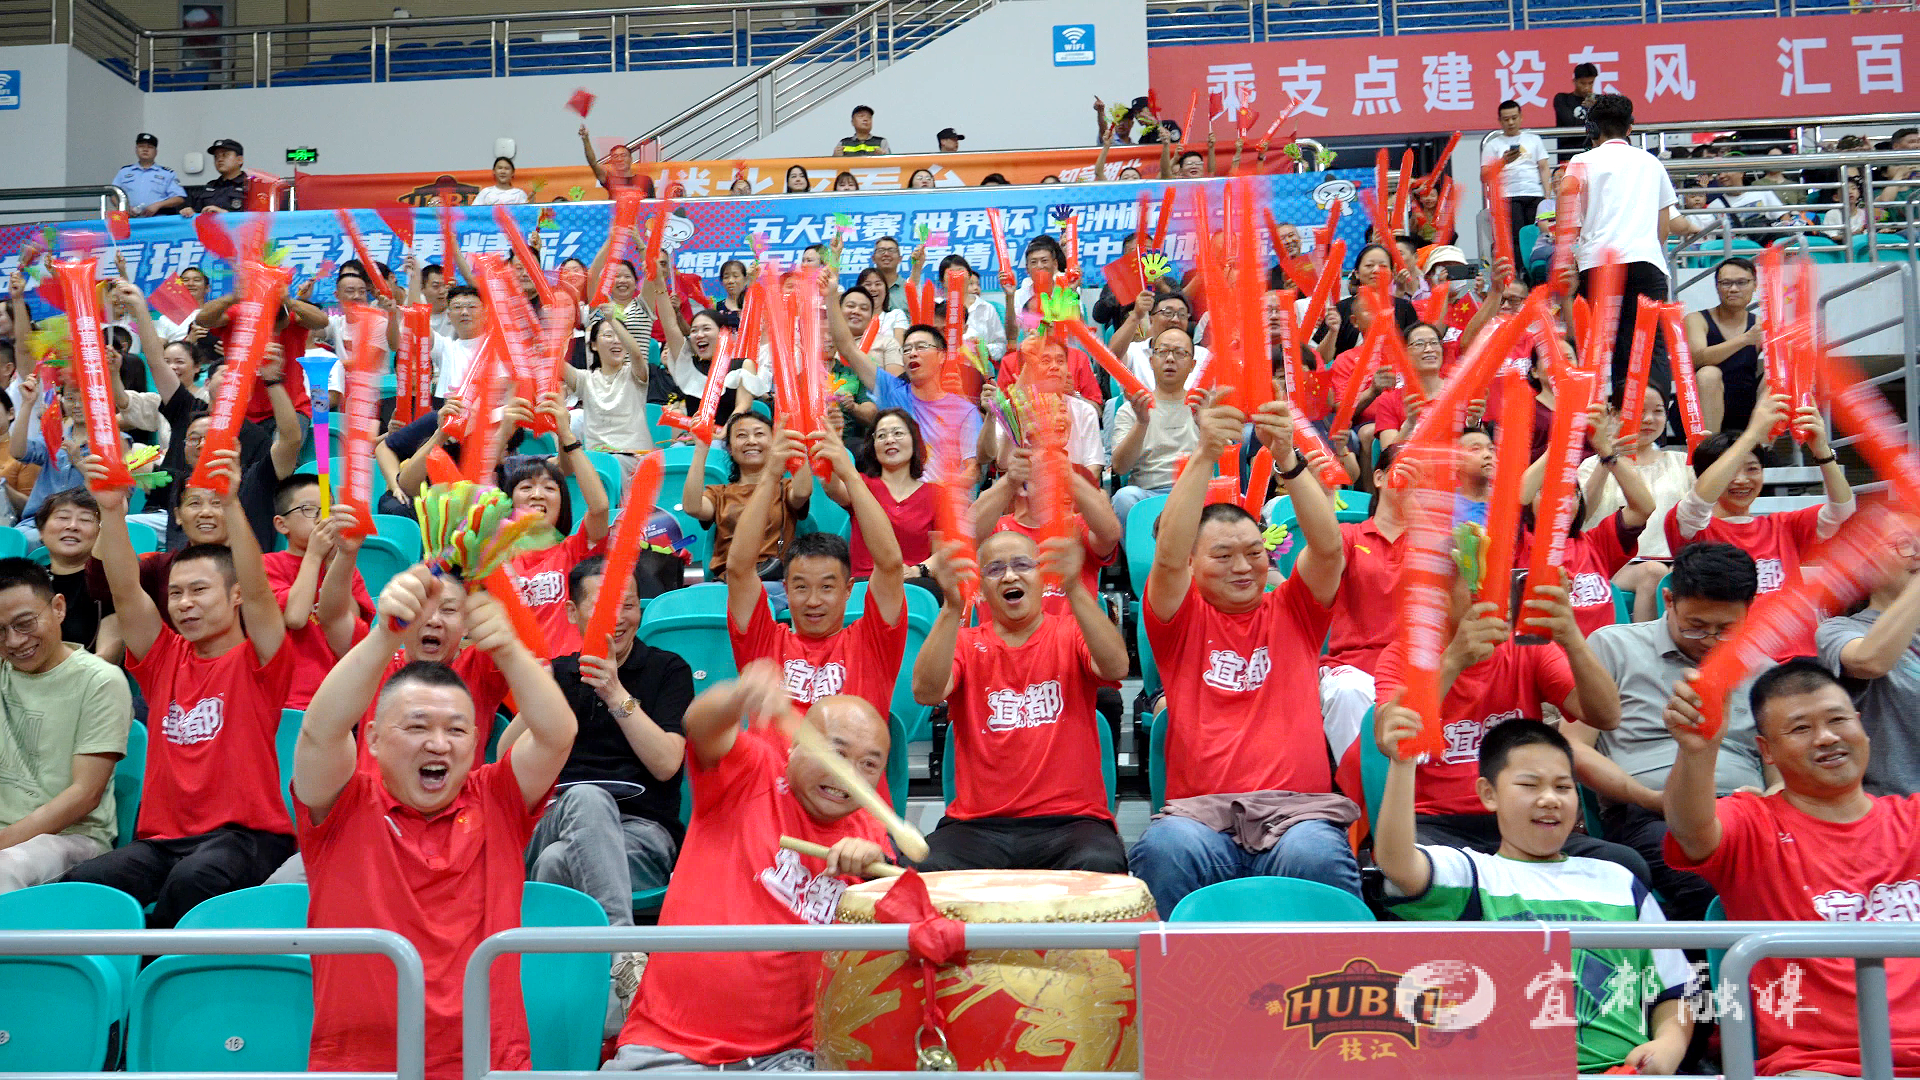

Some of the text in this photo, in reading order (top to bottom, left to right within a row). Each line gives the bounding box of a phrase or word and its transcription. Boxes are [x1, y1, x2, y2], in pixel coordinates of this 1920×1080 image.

[1206, 34, 1904, 123] 乘支点建设东风 汇百
[748, 213, 903, 245] 五大联赛
[913, 207, 1036, 240] 世界杯
[783, 658, 847, 704] 宜都
[1202, 646, 1272, 692] 宜都
[161, 696, 225, 745] 宜都
[986, 680, 1064, 732] 宜都
[1442, 708, 1524, 765] 宜
[760, 847, 849, 925] 宜都
[1290, 984, 1438, 1024] HUBEI
[1338, 1037, 1399, 1062] 枝江
